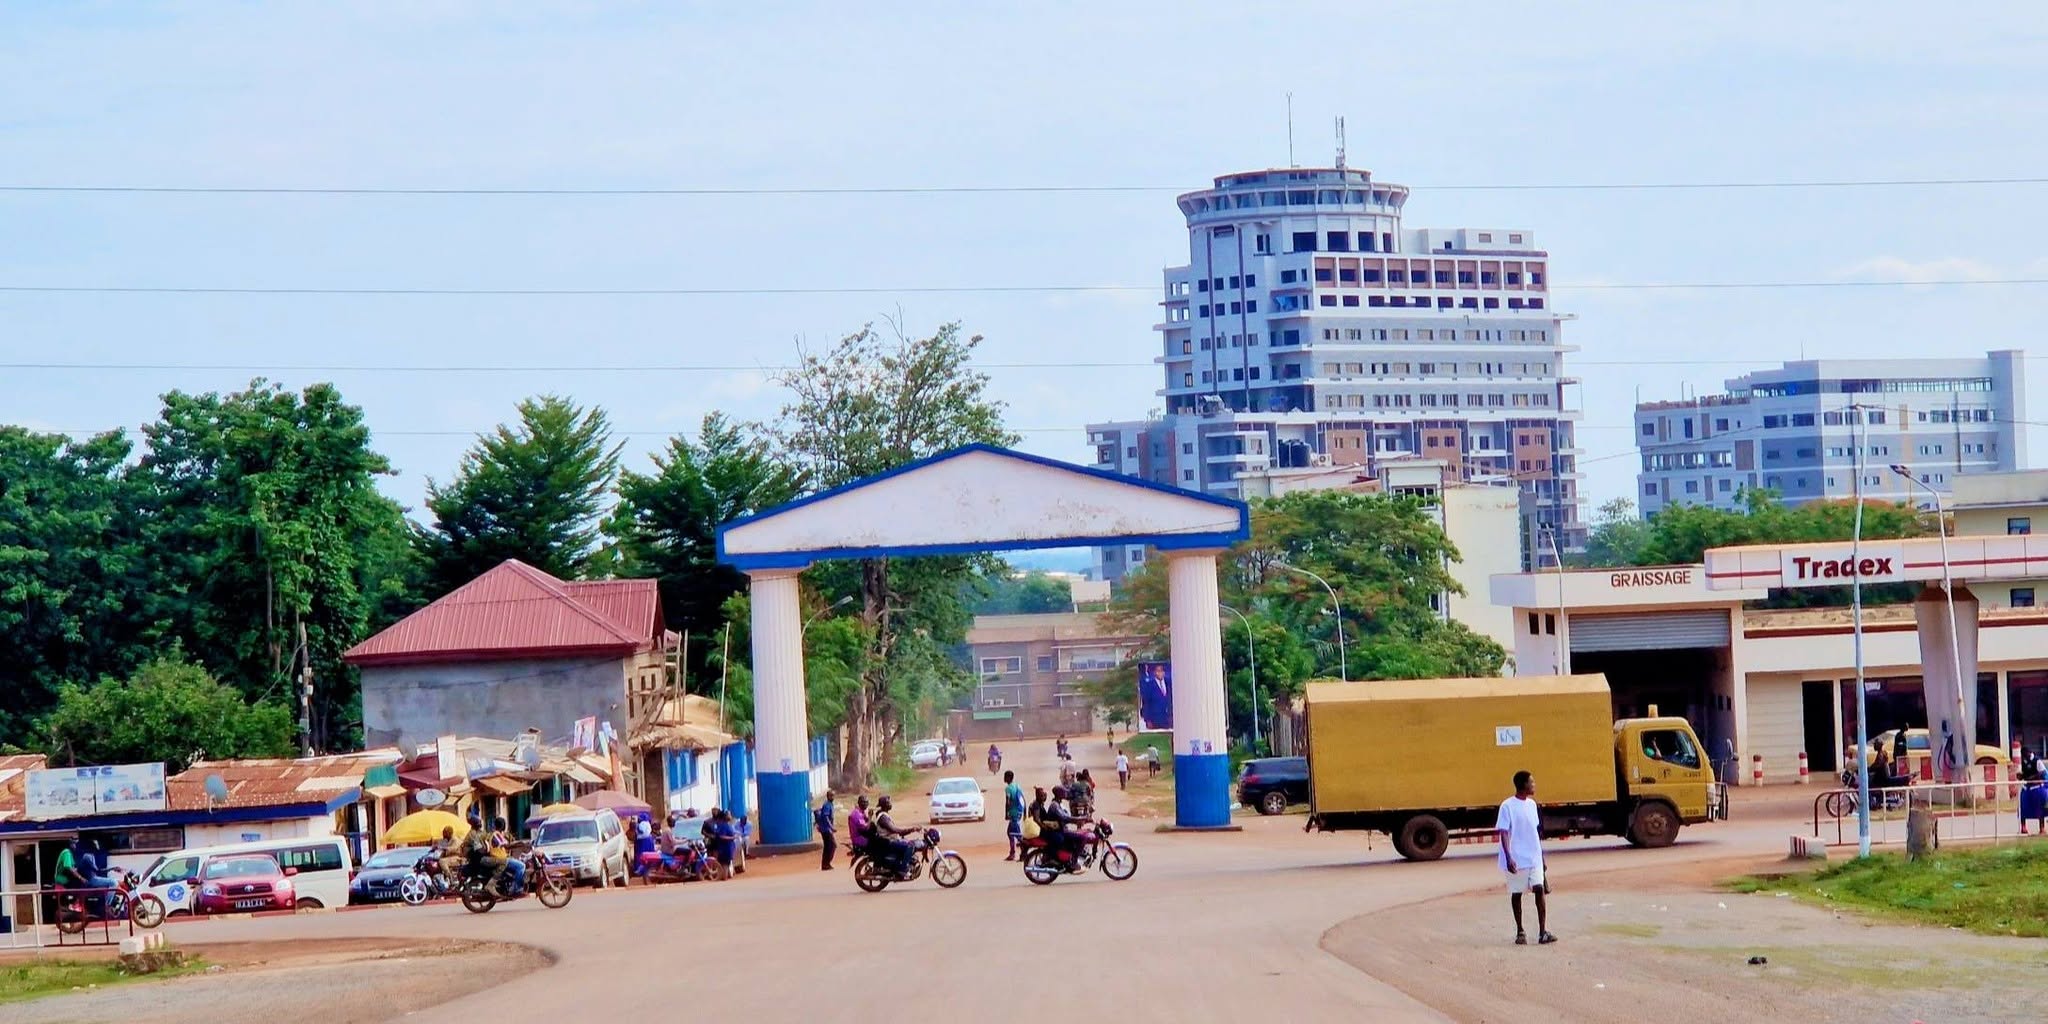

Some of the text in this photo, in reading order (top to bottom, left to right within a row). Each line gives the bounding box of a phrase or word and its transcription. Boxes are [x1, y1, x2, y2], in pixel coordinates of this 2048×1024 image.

[1793, 556, 1892, 579] Tradex
[1611, 571, 1691, 587] GRAISSAGE
[77, 766, 112, 778] ETC
